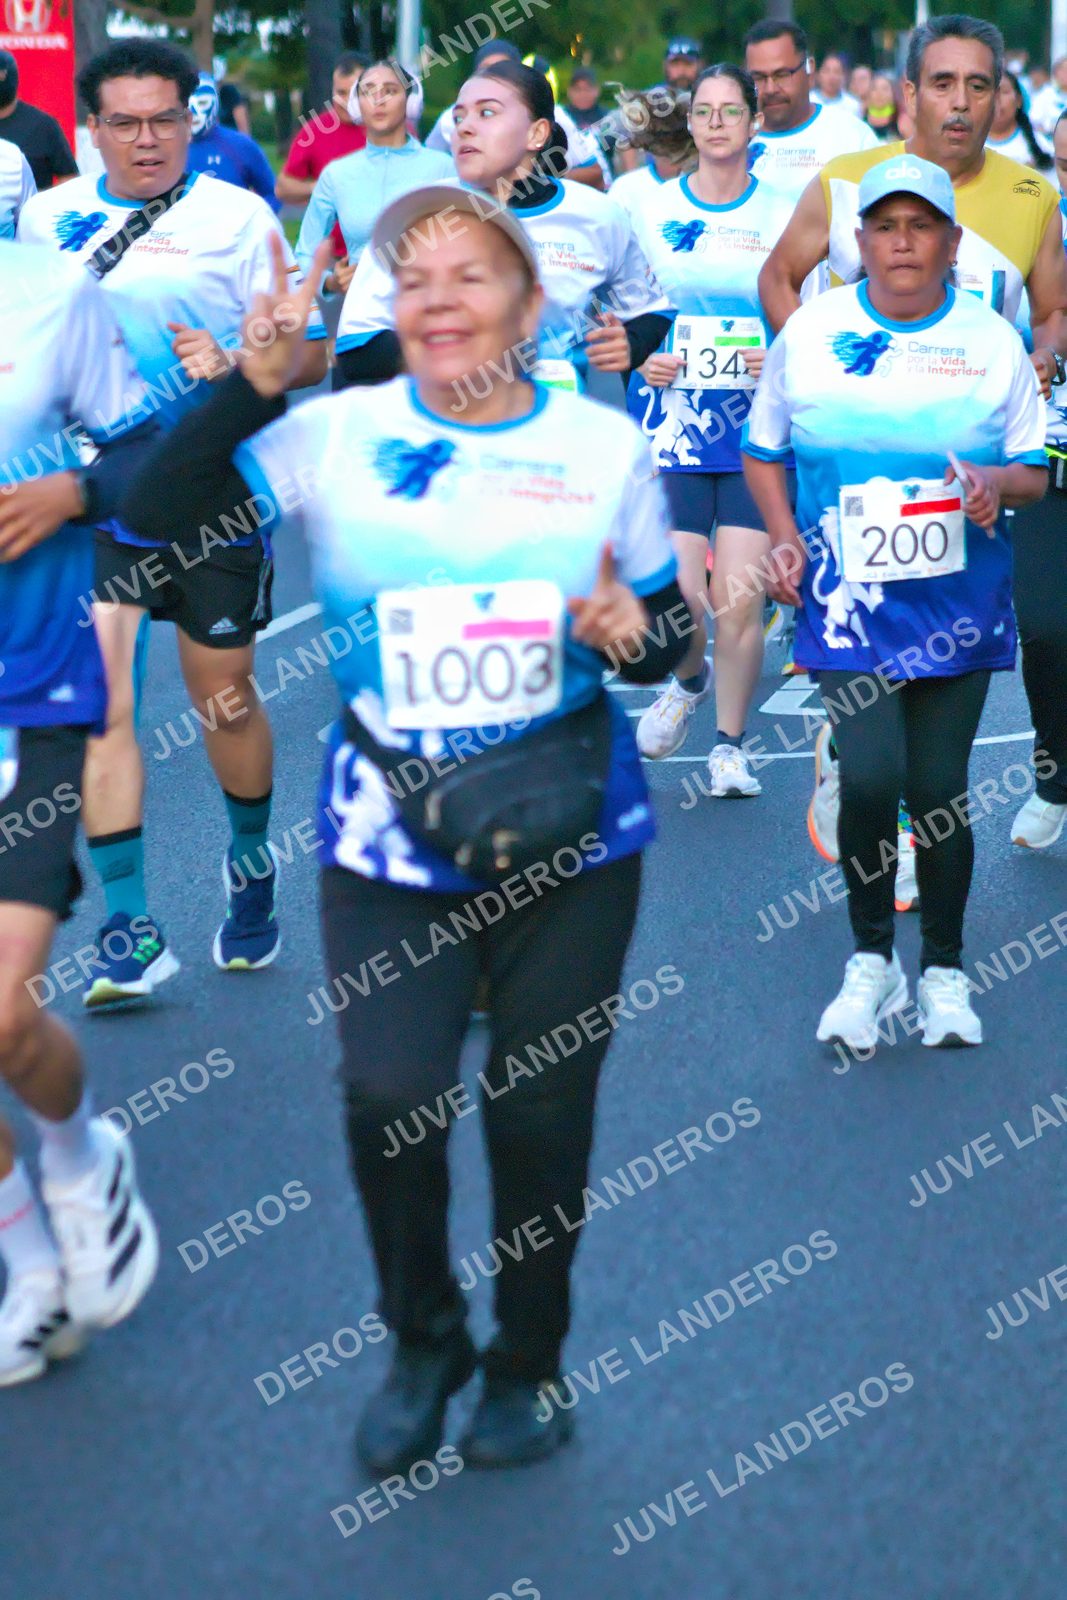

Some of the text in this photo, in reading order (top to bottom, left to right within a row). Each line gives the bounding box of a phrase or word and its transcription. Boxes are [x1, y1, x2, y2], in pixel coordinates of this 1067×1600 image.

[885, 161, 922, 179] alo
[718, 226, 760, 238] Carrera
[734, 243, 773, 254] Integrida
[743, 236, 761, 246] Vida
[907, 340, 965, 357] Carrera
[679, 347, 750, 379] 134
[907, 355, 925, 364] por
[940, 356, 966, 367] Vida
[928, 365, 987, 378] Integridad
[861, 520, 948, 568] 200
[398, 640, 554, 709] 1003
